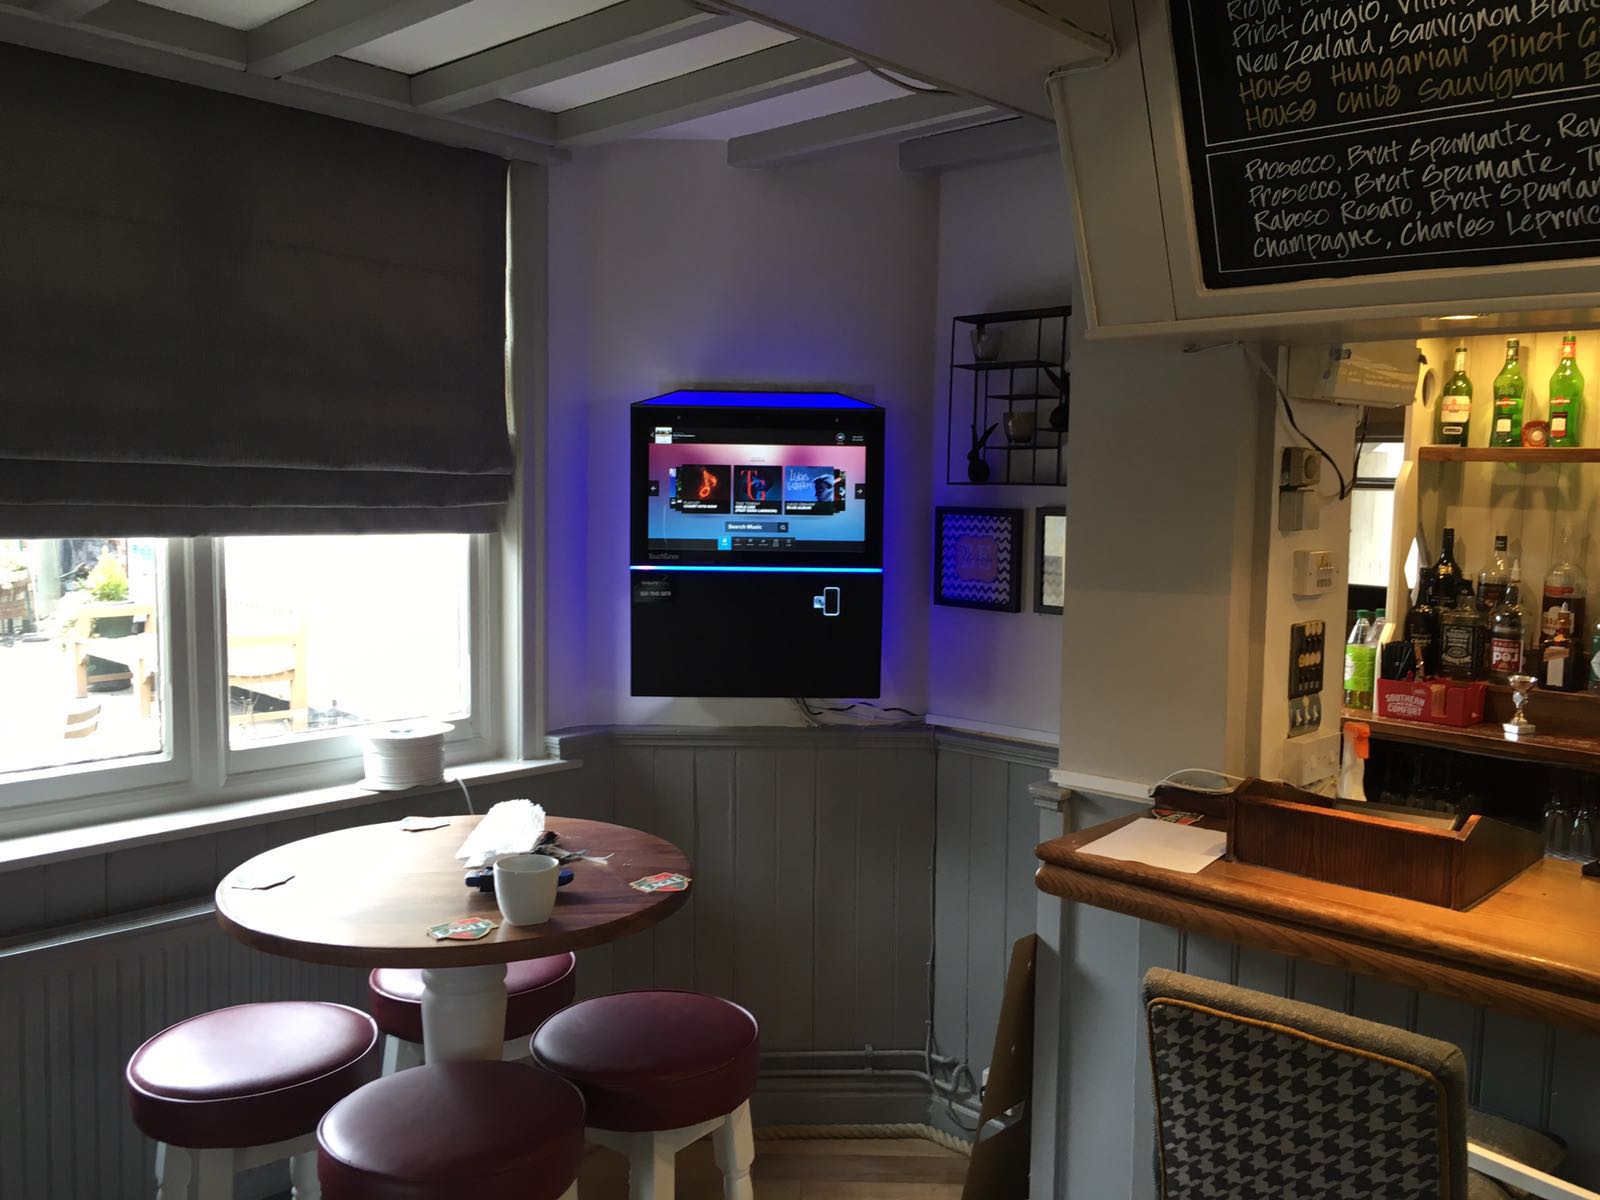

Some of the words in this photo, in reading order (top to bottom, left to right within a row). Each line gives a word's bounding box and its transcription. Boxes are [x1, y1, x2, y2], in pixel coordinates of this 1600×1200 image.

[1232, 15, 1293, 48] Pinot
[1301, 0, 1389, 35] Grigio,
[1236, 51, 1278, 76] New
[1284, 29, 1384, 71] Zealand,
[1389, 4, 1521, 49] Sauvignon
[1331, 44, 1469, 88] Hungarian
[1487, 22, 1571, 64] Pinot
[1577, 16, 1600, 48] G
[1418, 62, 1565, 102] Sauvignon
[1244, 154, 1342, 182] Prosecco,
[1347, 139, 1403, 171] Brut
[1408, 119, 1551, 162] Spumante,
[1248, 179, 1348, 208] Prosecco,
[1354, 167, 1415, 199] Brut
[1421, 150, 1576, 191] Spumante,
[1253, 208, 1330, 233] Raboso
[1340, 195, 1421, 225] Rosato,
[1429, 185, 1493, 215] Brut
[1253, 228, 1392, 260] Champagne,
[1400, 213, 1495, 246] Charles
[1385, 693, 1426, 706] SOUTHERN
[1387, 703, 1423, 715] COMFORT
